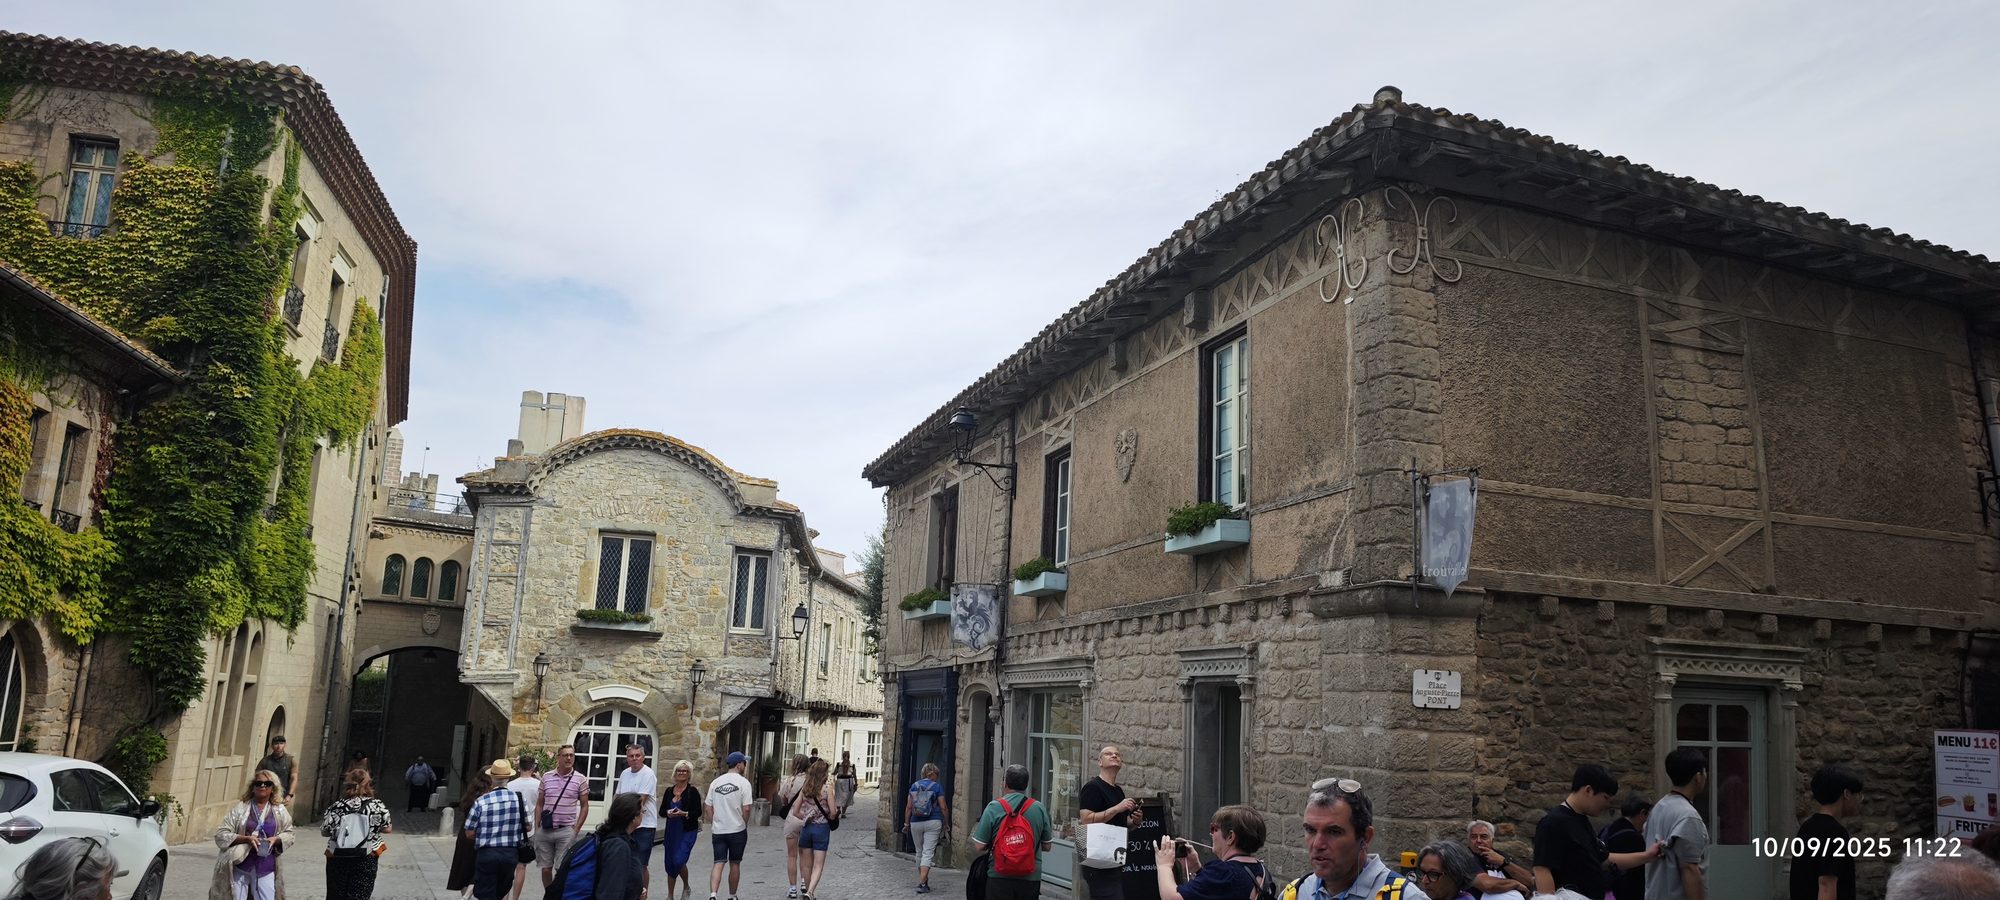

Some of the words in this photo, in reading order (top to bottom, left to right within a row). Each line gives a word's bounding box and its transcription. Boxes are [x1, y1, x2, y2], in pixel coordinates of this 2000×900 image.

[1428, 681, 1447, 689] Place
[1415, 689, 1460, 697] Auguste-Pierre
[1427, 697, 1448, 705] PONT
[1938, 736, 1970, 747] MENU
[1974, 738, 1997, 749] 11€
[1955, 820, 1993, 833] FRITE
[1128, 840, 1142, 852] 30
[1143, 840, 1151, 851] %
